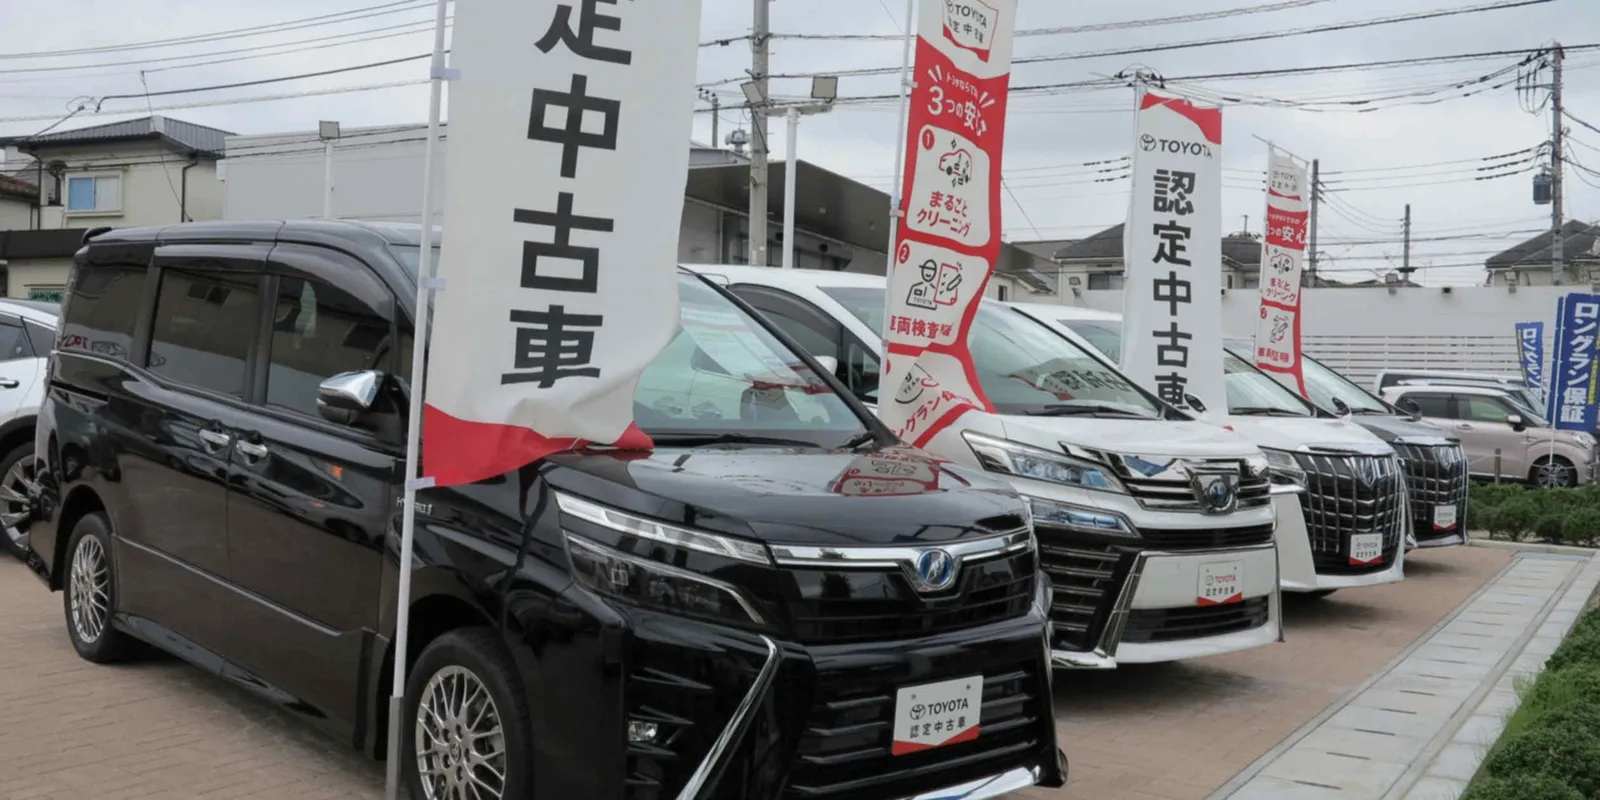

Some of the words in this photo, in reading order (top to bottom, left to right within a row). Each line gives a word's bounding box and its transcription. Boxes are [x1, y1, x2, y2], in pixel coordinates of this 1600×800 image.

[1158, 138, 1213, 160] TOYOTA
[1152, 168, 1196, 410] 認定中古車
[1560, 302, 1599, 424] ロングラン保証
[928, 698, 968, 715] TOYOTA
